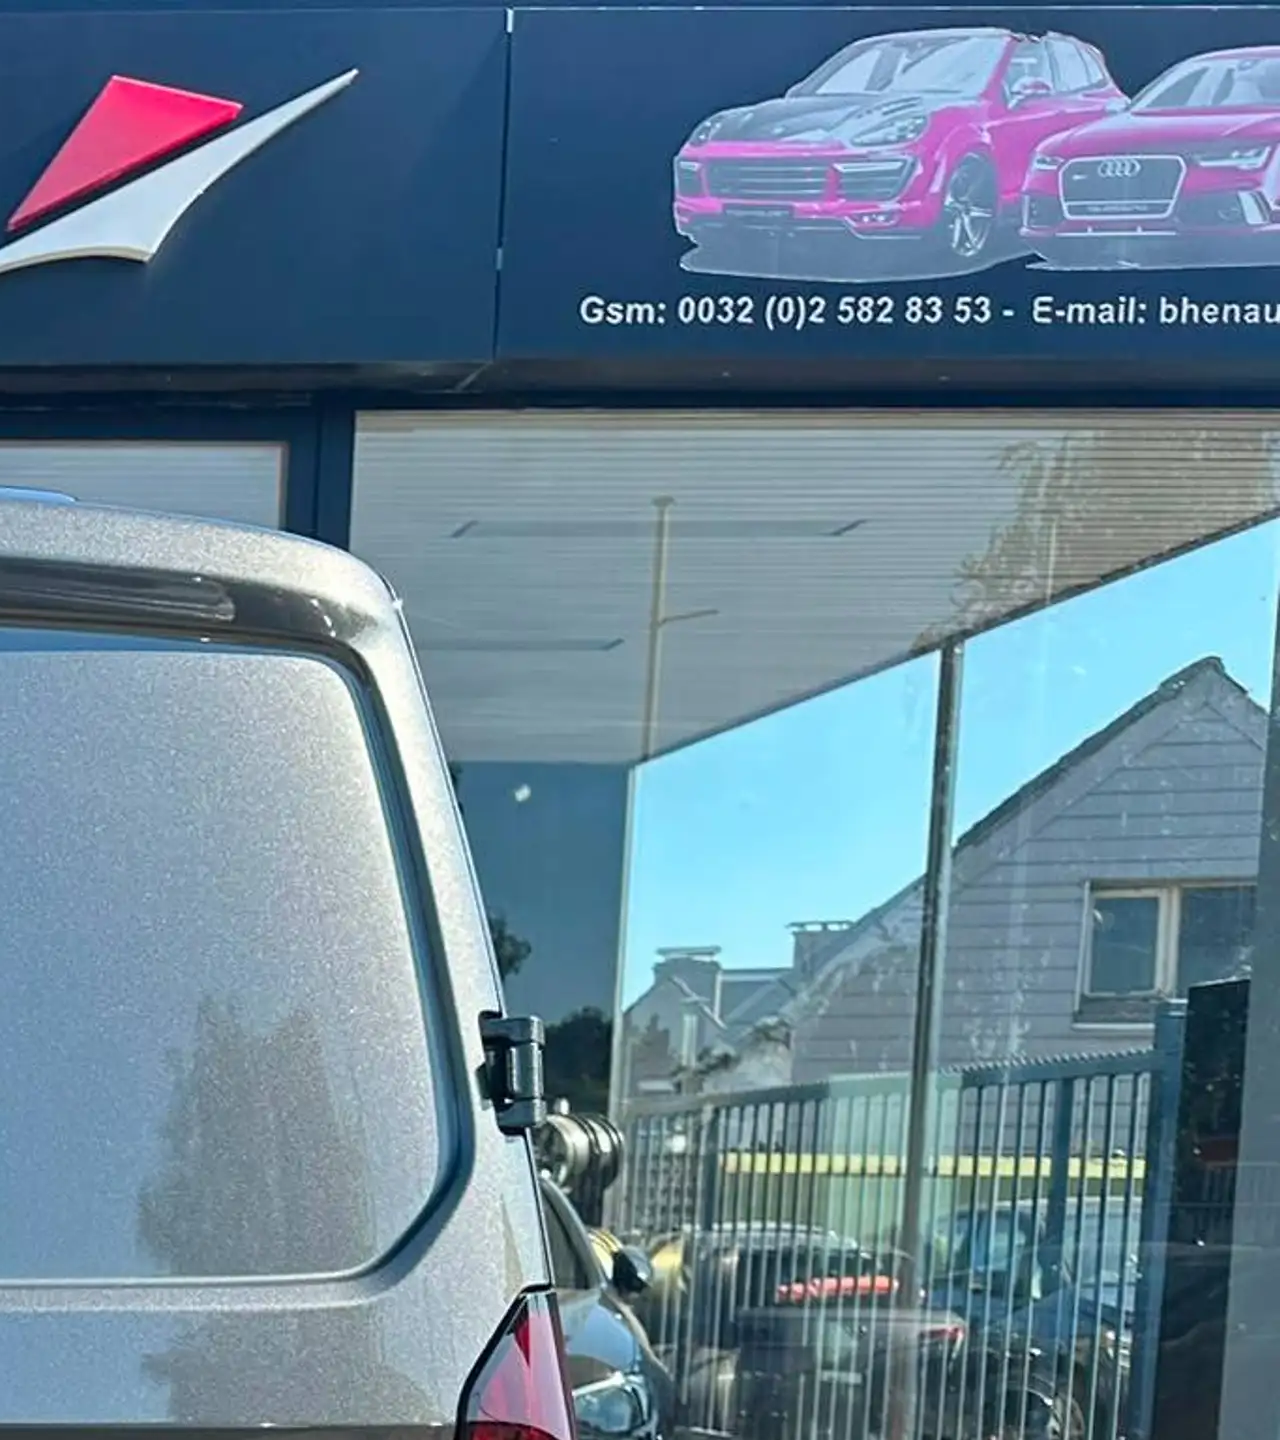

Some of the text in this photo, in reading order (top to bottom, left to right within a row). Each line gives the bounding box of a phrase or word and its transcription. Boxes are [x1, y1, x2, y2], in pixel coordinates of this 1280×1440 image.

[580, 296, 666, 324] Gsm:
[678, 296, 754, 324] 0032
[765, 295, 826, 330] (0)2
[837, 296, 894, 324] 582
[905, 296, 943, 324] 83
[954, 296, 991, 324] 53
[1032, 296, 1146, 324] E-mail:
[1159, 296, 1280, 324] bhenau
